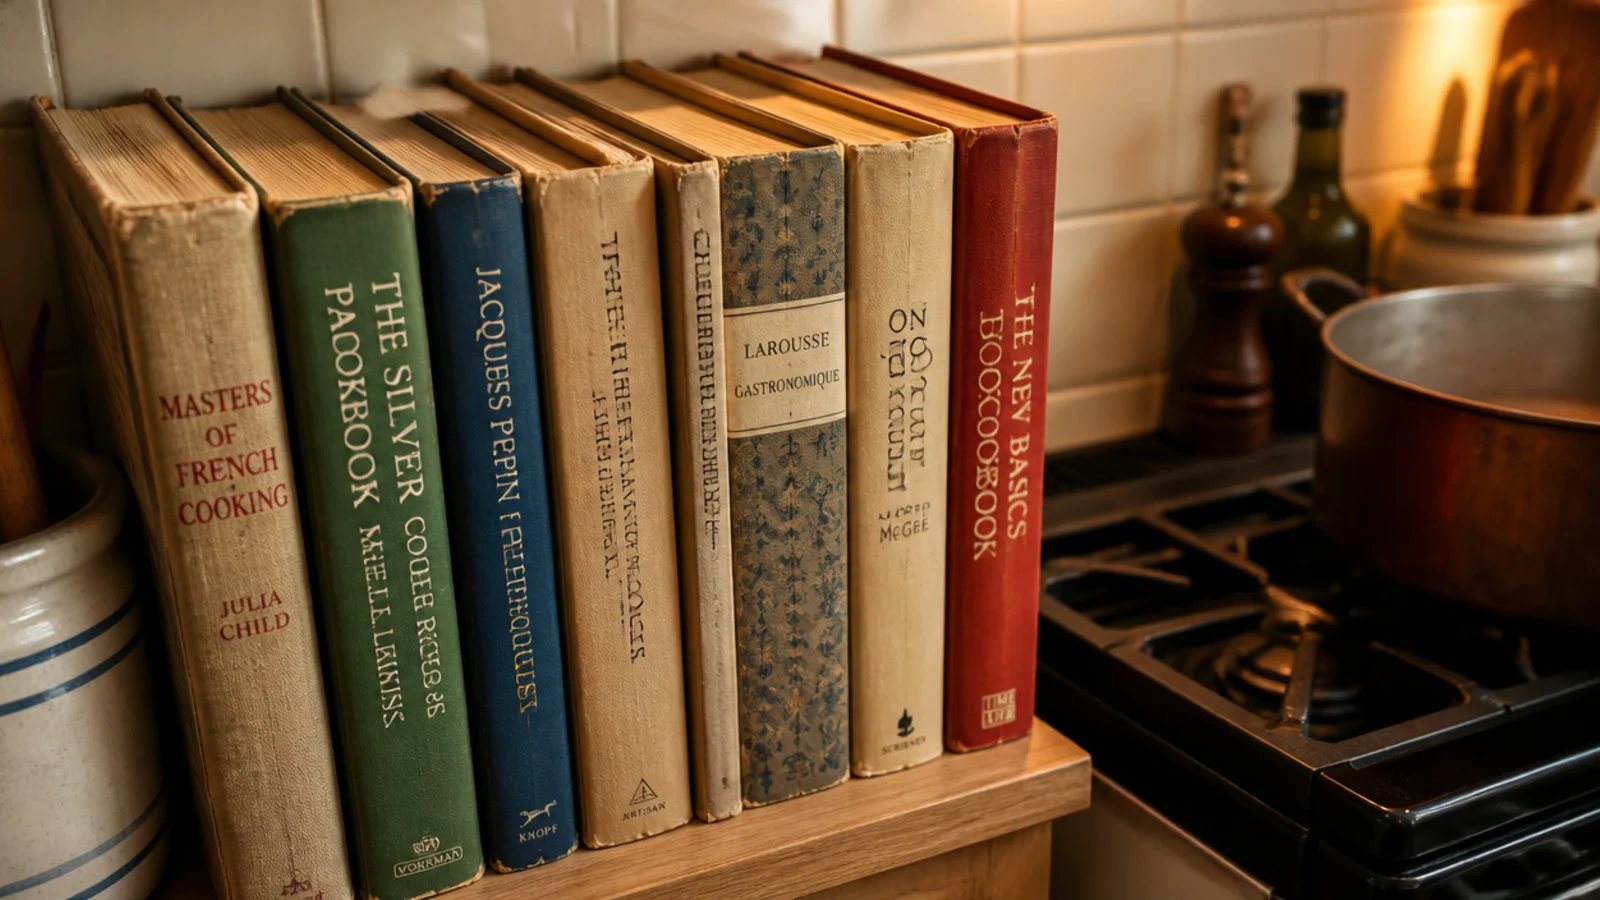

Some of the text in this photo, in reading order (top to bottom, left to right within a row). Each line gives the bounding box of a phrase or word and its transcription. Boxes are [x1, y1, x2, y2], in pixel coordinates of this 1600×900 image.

[371, 271, 409, 355] THE
[743, 331, 830, 360] LAROUSSE
[159, 379, 272, 421] MASTERS
[734, 369, 840, 399] GASTRONOMIQUE
[205, 423, 237, 448] OF
[383, 364, 425, 504] SILVER
[175, 446, 279, 488] FRENCH
[178, 483, 289, 526] COOKING
[220, 589, 283, 619] JULIA
[219, 611, 290, 642] CHILD
